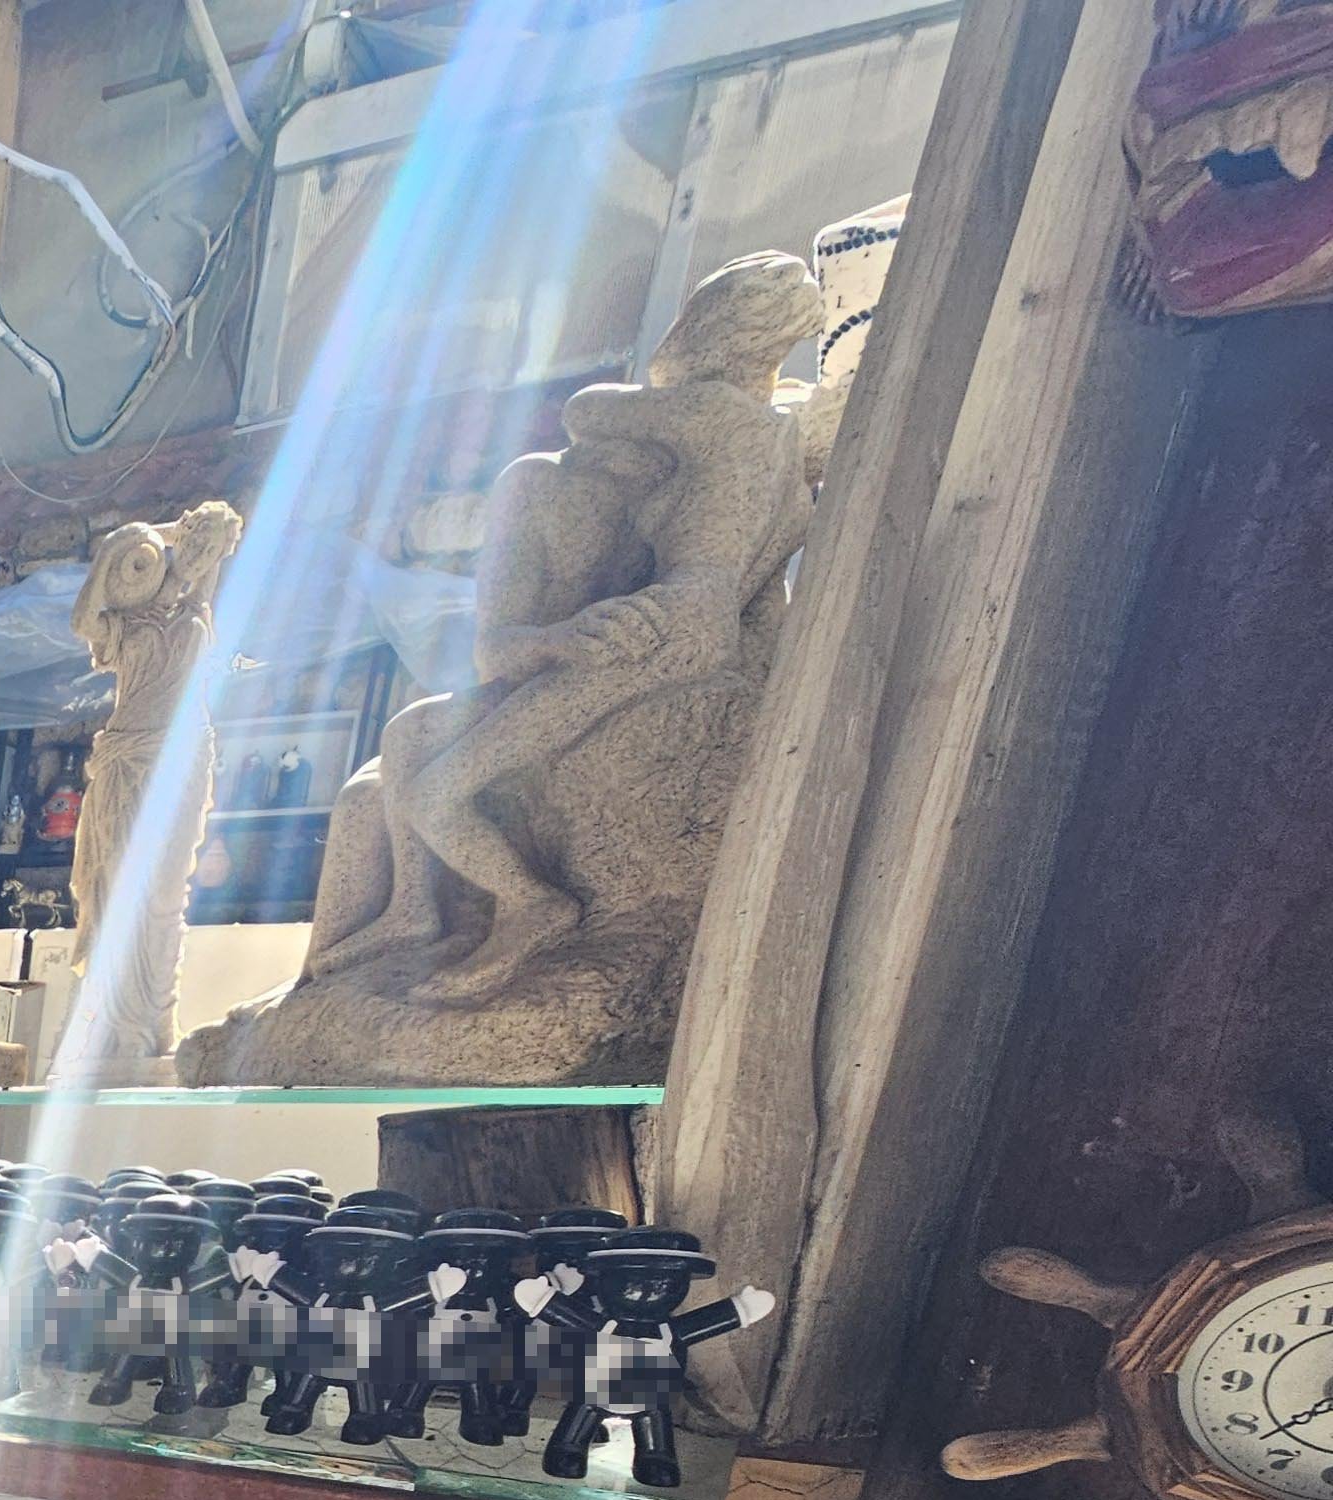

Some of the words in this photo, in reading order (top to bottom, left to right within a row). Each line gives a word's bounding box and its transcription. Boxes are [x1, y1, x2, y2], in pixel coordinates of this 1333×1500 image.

[1242, 1332, 1286, 1355] 10
[1220, 1369, 1254, 1393] 9
[1223, 1411, 1260, 1436] 8
[1266, 1447, 1302, 1471] 7
